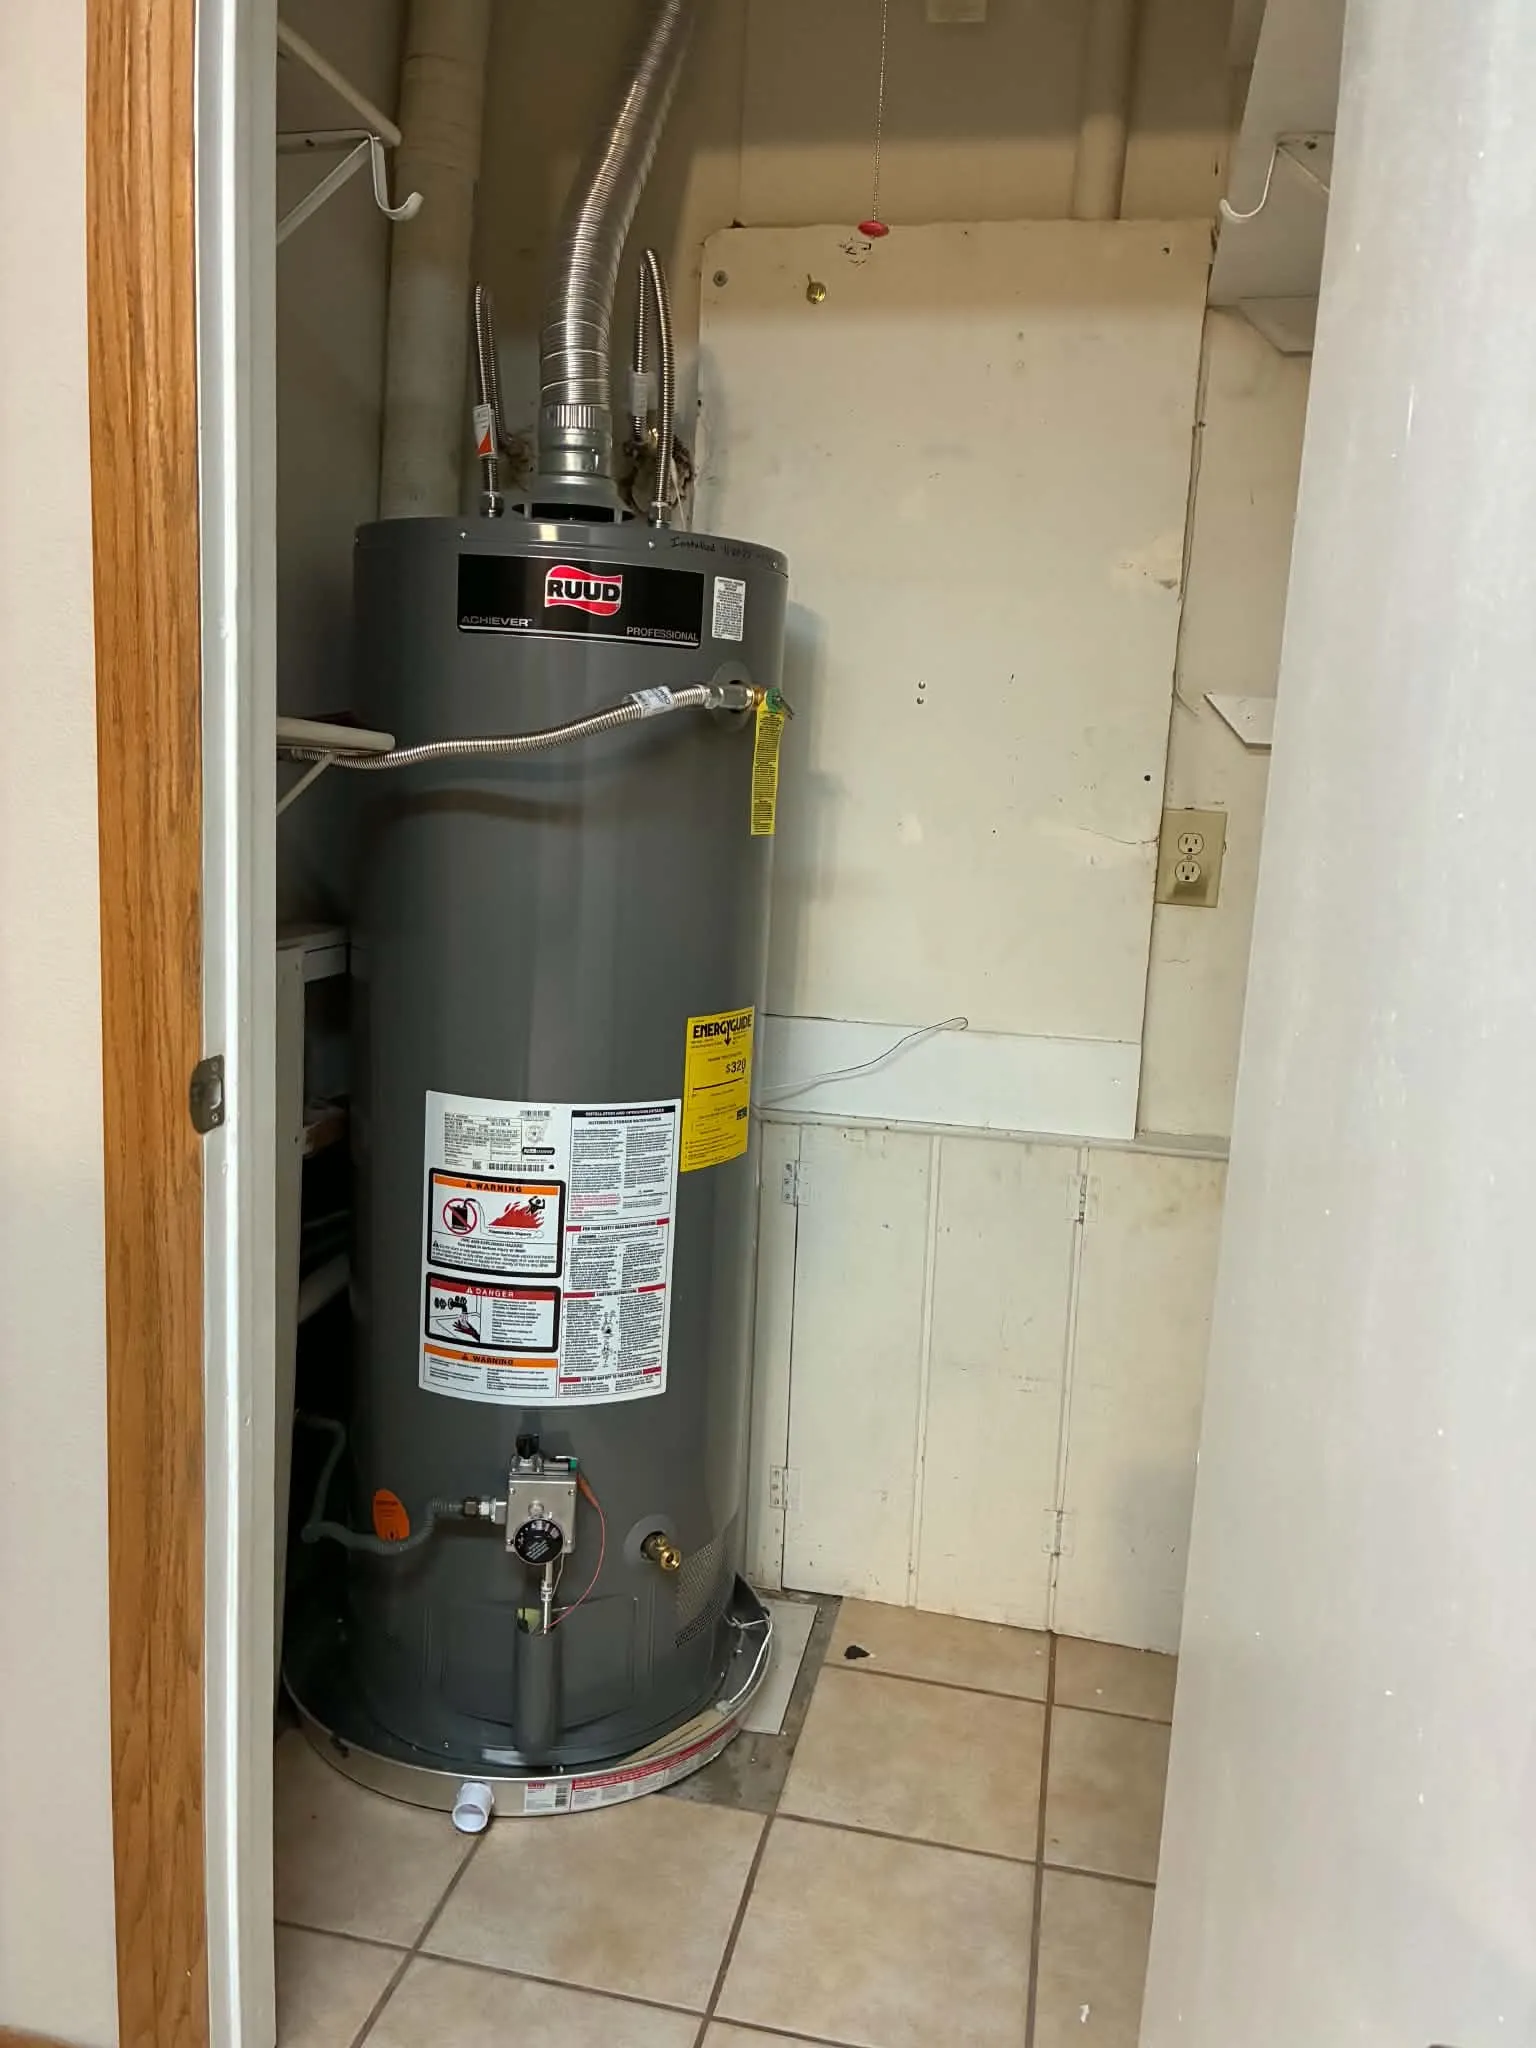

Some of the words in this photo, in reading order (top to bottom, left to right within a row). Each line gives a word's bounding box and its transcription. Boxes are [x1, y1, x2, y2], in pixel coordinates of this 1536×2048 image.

[546, 579, 620, 601] RUUD
[626, 626, 699, 641] PROFESSIONAL
[693, 1014, 752, 1039] ENERGYGUIDE
[474, 1182, 522, 1193] WARNING
[475, 1287, 514, 1298] DANGER
[472, 1355, 514, 1366] WARNING
